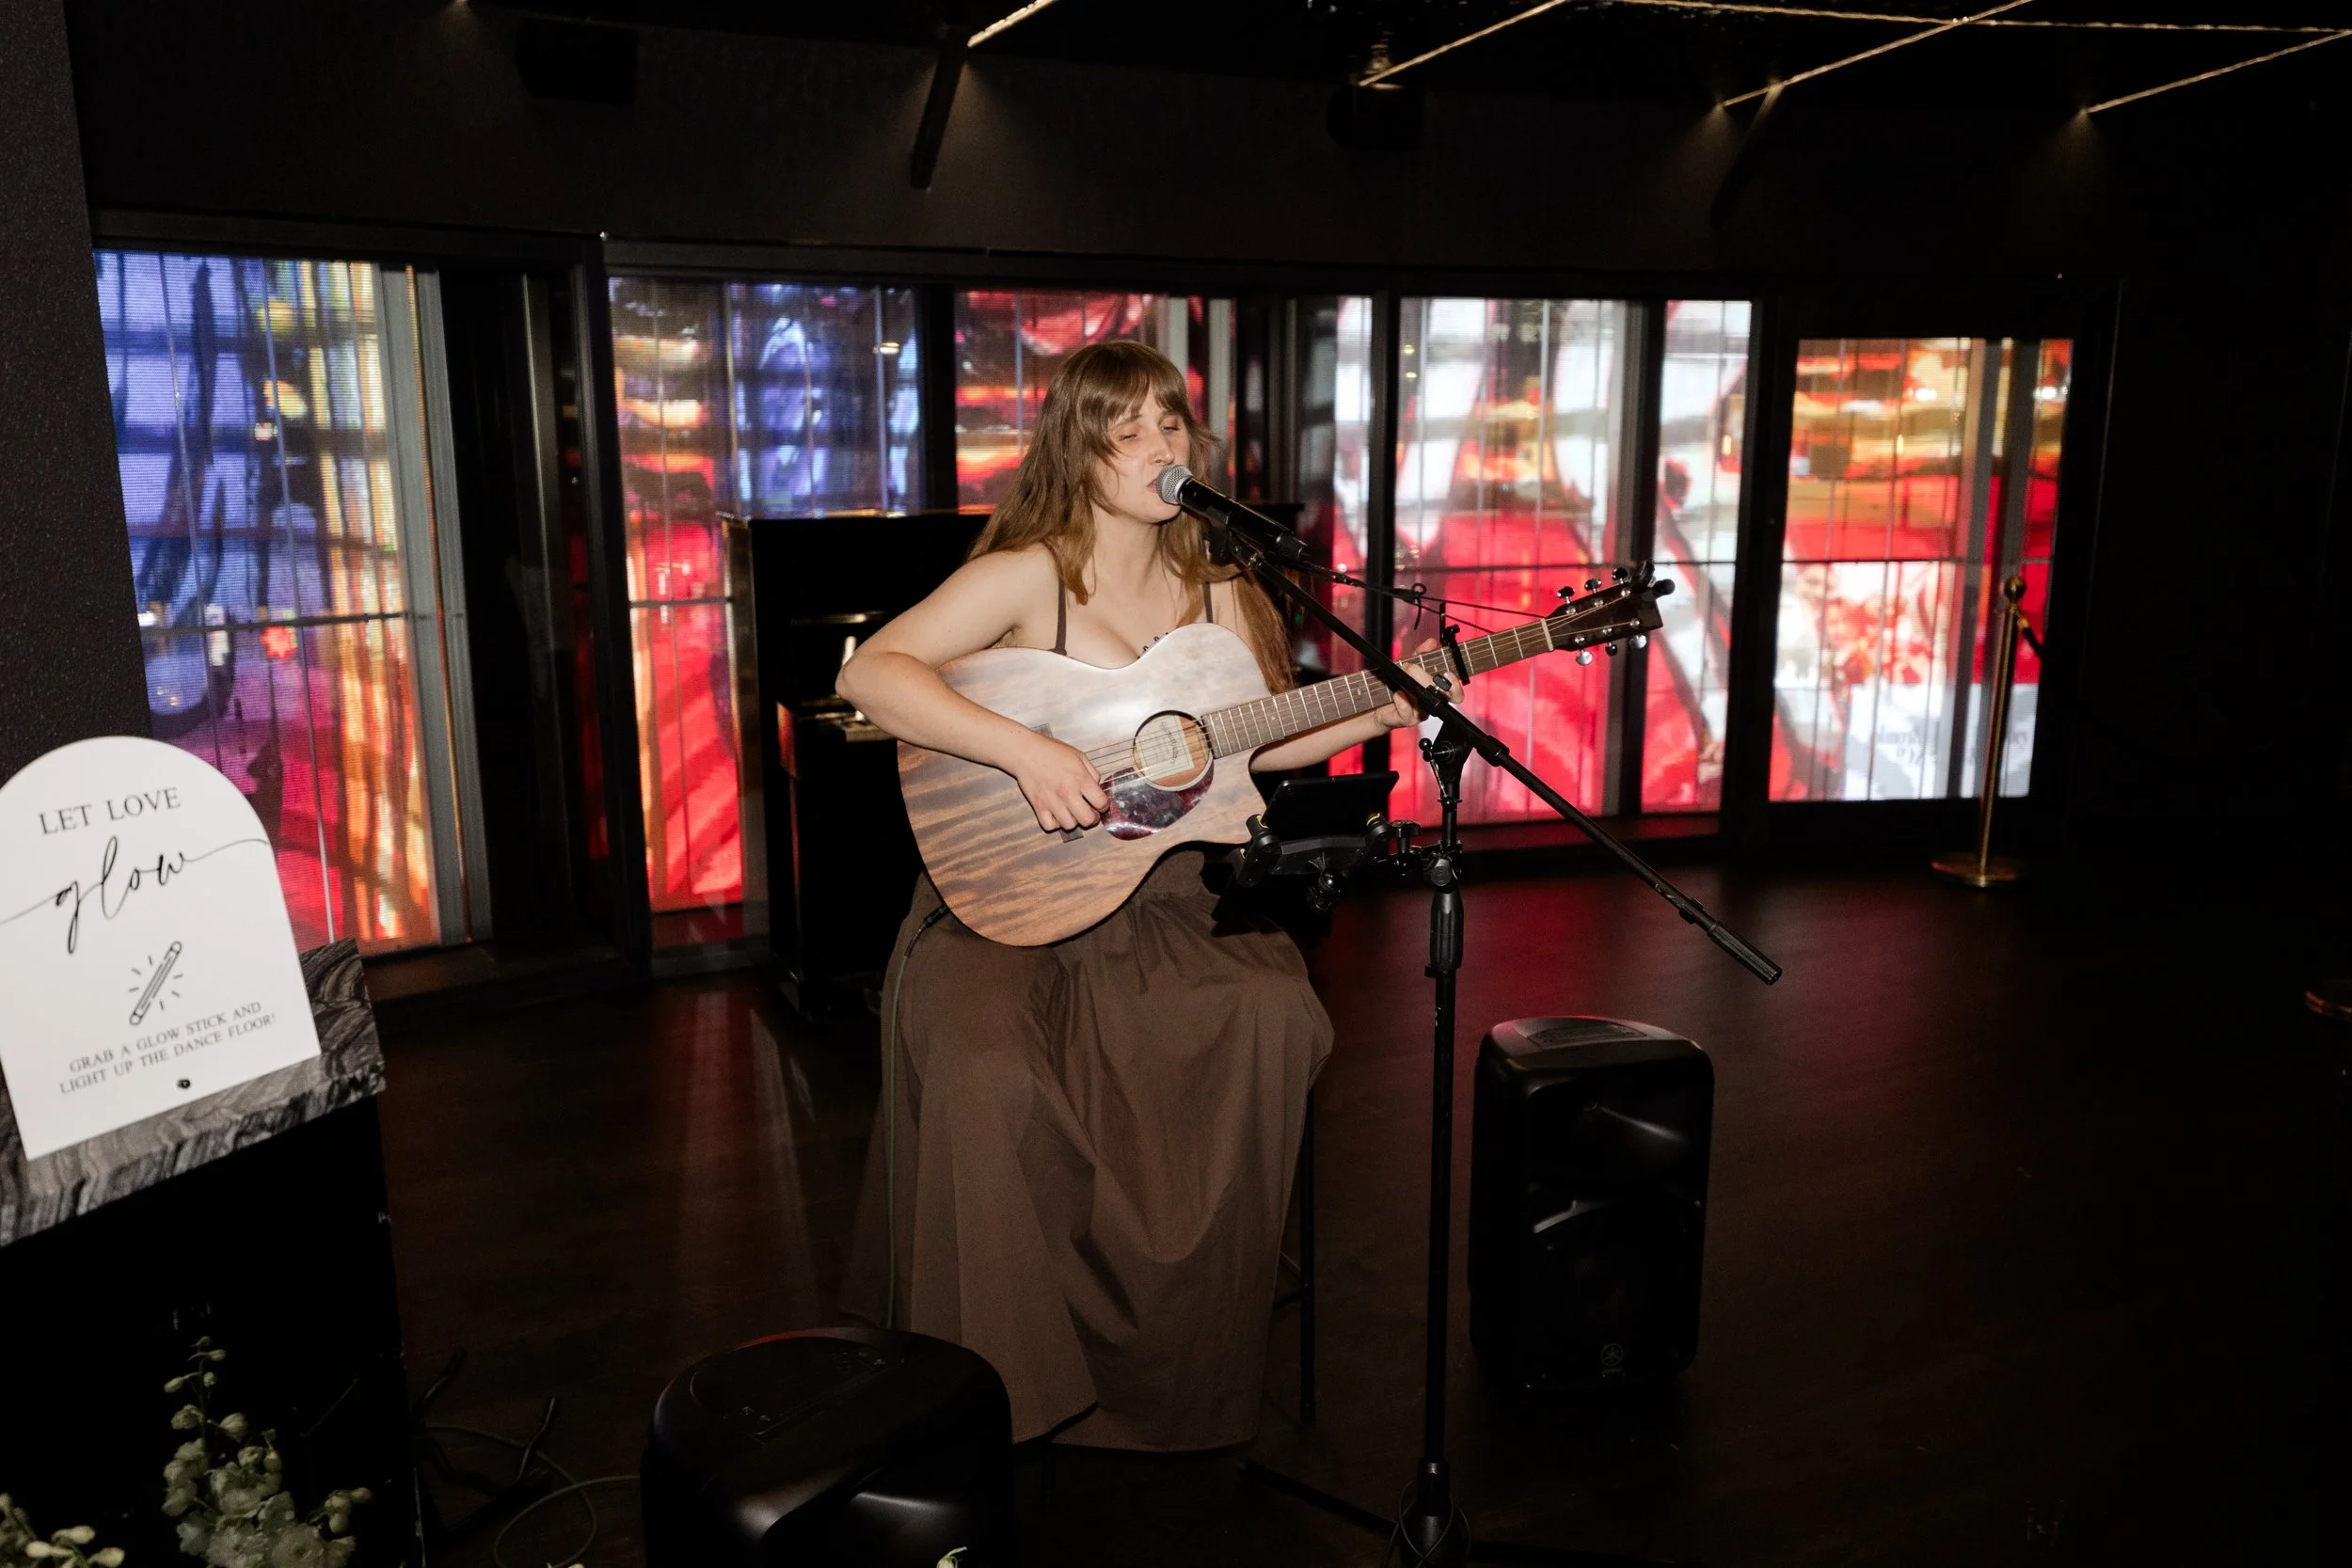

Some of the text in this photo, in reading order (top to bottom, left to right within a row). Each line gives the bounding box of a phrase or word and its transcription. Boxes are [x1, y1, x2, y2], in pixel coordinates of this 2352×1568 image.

[39, 787, 181, 835] LET LOVE
[52, 834, 190, 955] glow
[59, 1013, 277, 1095] LIGHT UP THE DANCE FLOOR!
[69, 1001, 262, 1073] GRAB A GLOW STICK AND
